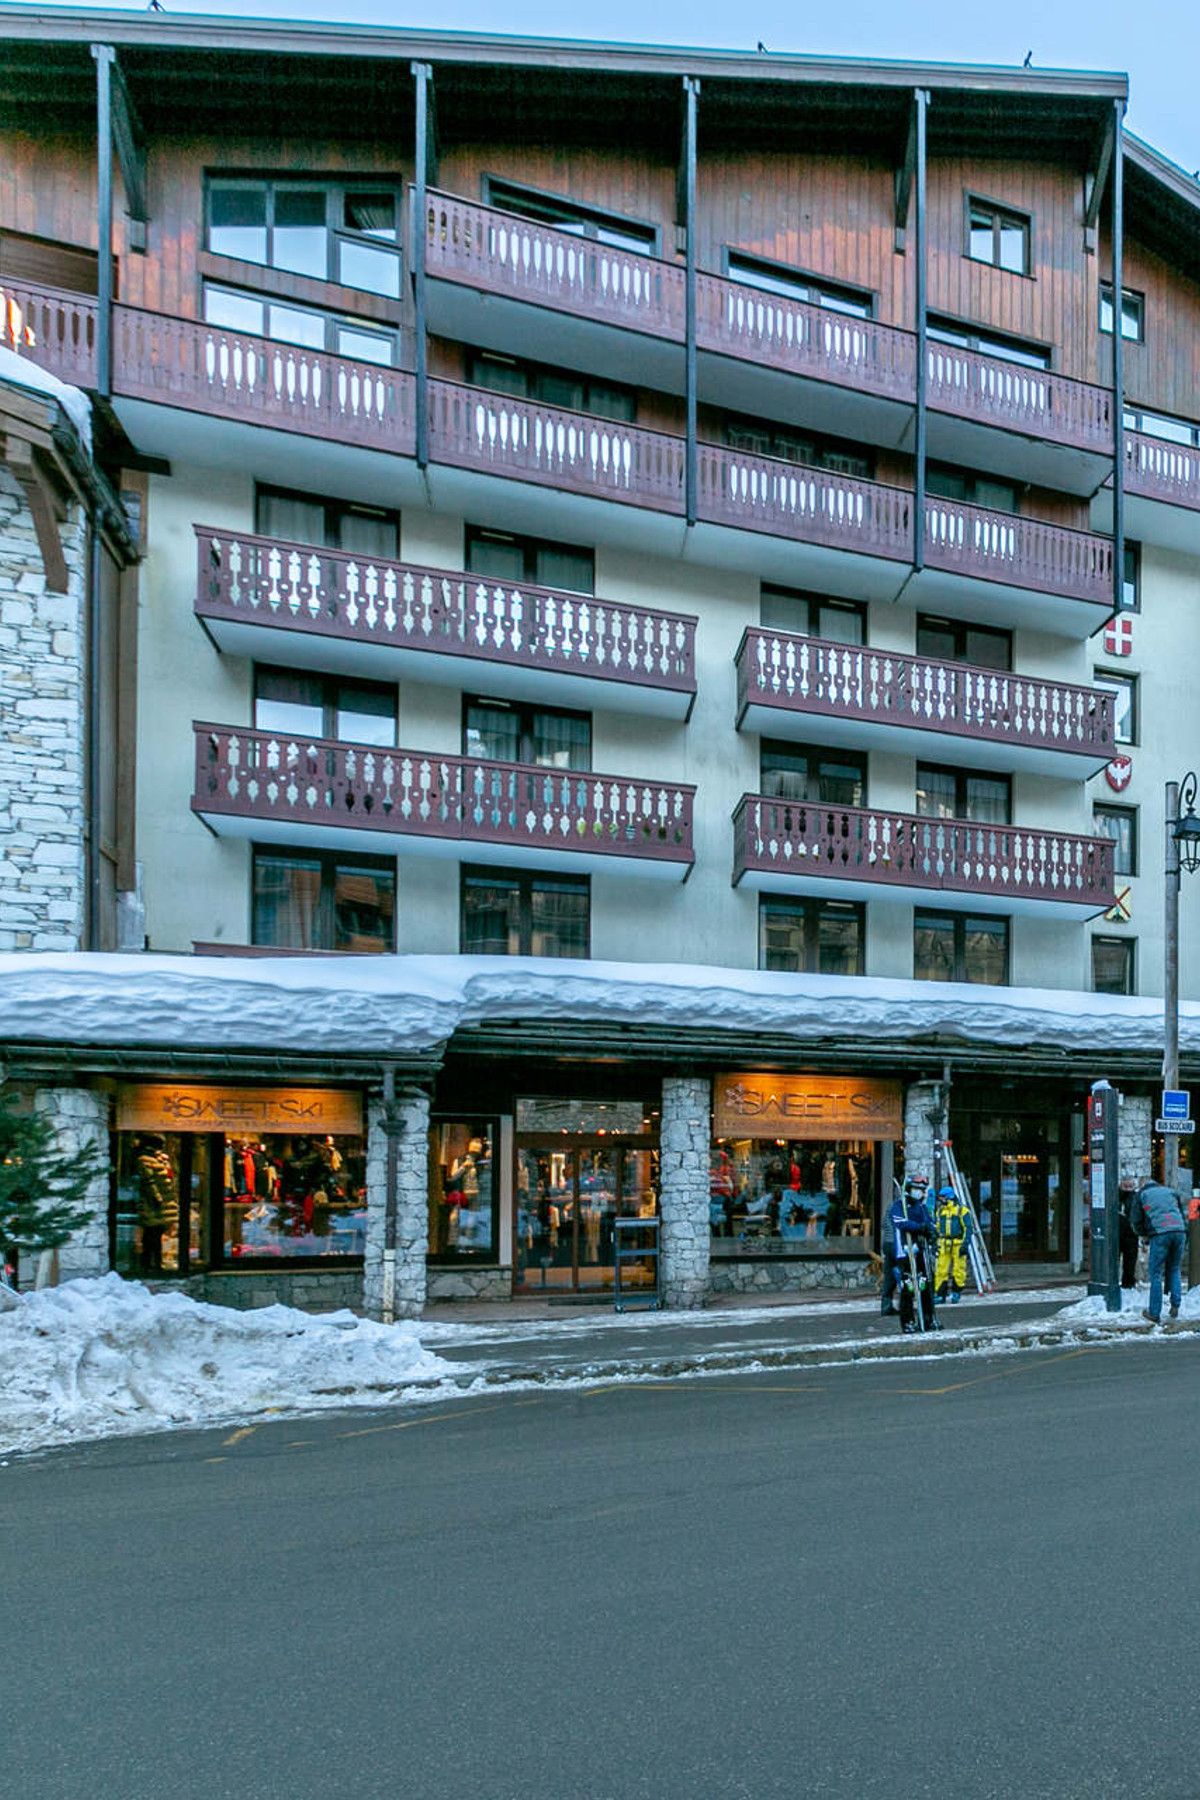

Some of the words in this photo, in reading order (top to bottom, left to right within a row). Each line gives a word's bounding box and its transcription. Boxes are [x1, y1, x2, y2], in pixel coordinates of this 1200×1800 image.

[175, 1095, 277, 1118] SWEET
[278, 1098, 323, 1117] SKI
[737, 1090, 847, 1118] SWEET
